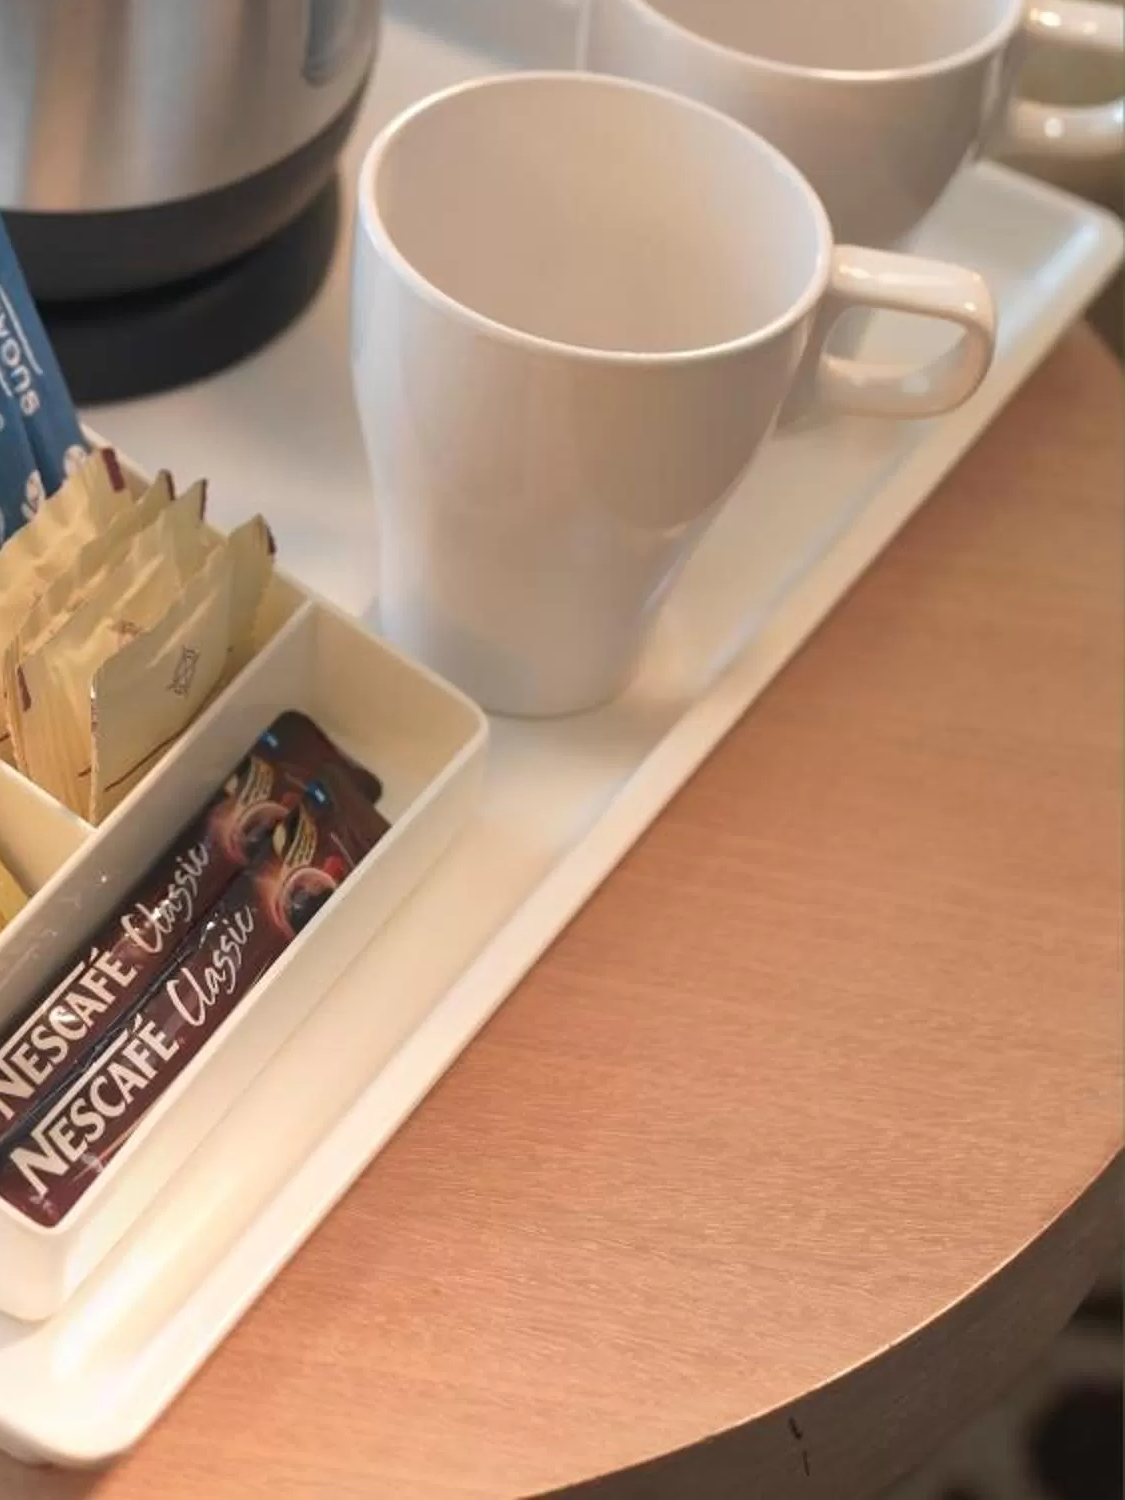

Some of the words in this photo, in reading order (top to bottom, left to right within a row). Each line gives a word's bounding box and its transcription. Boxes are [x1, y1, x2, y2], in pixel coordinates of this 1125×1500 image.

[120, 840, 211, 955] Classic
[9, 1014, 180, 1199] NESCAFÉ
[165, 907, 256, 1028] Classic
